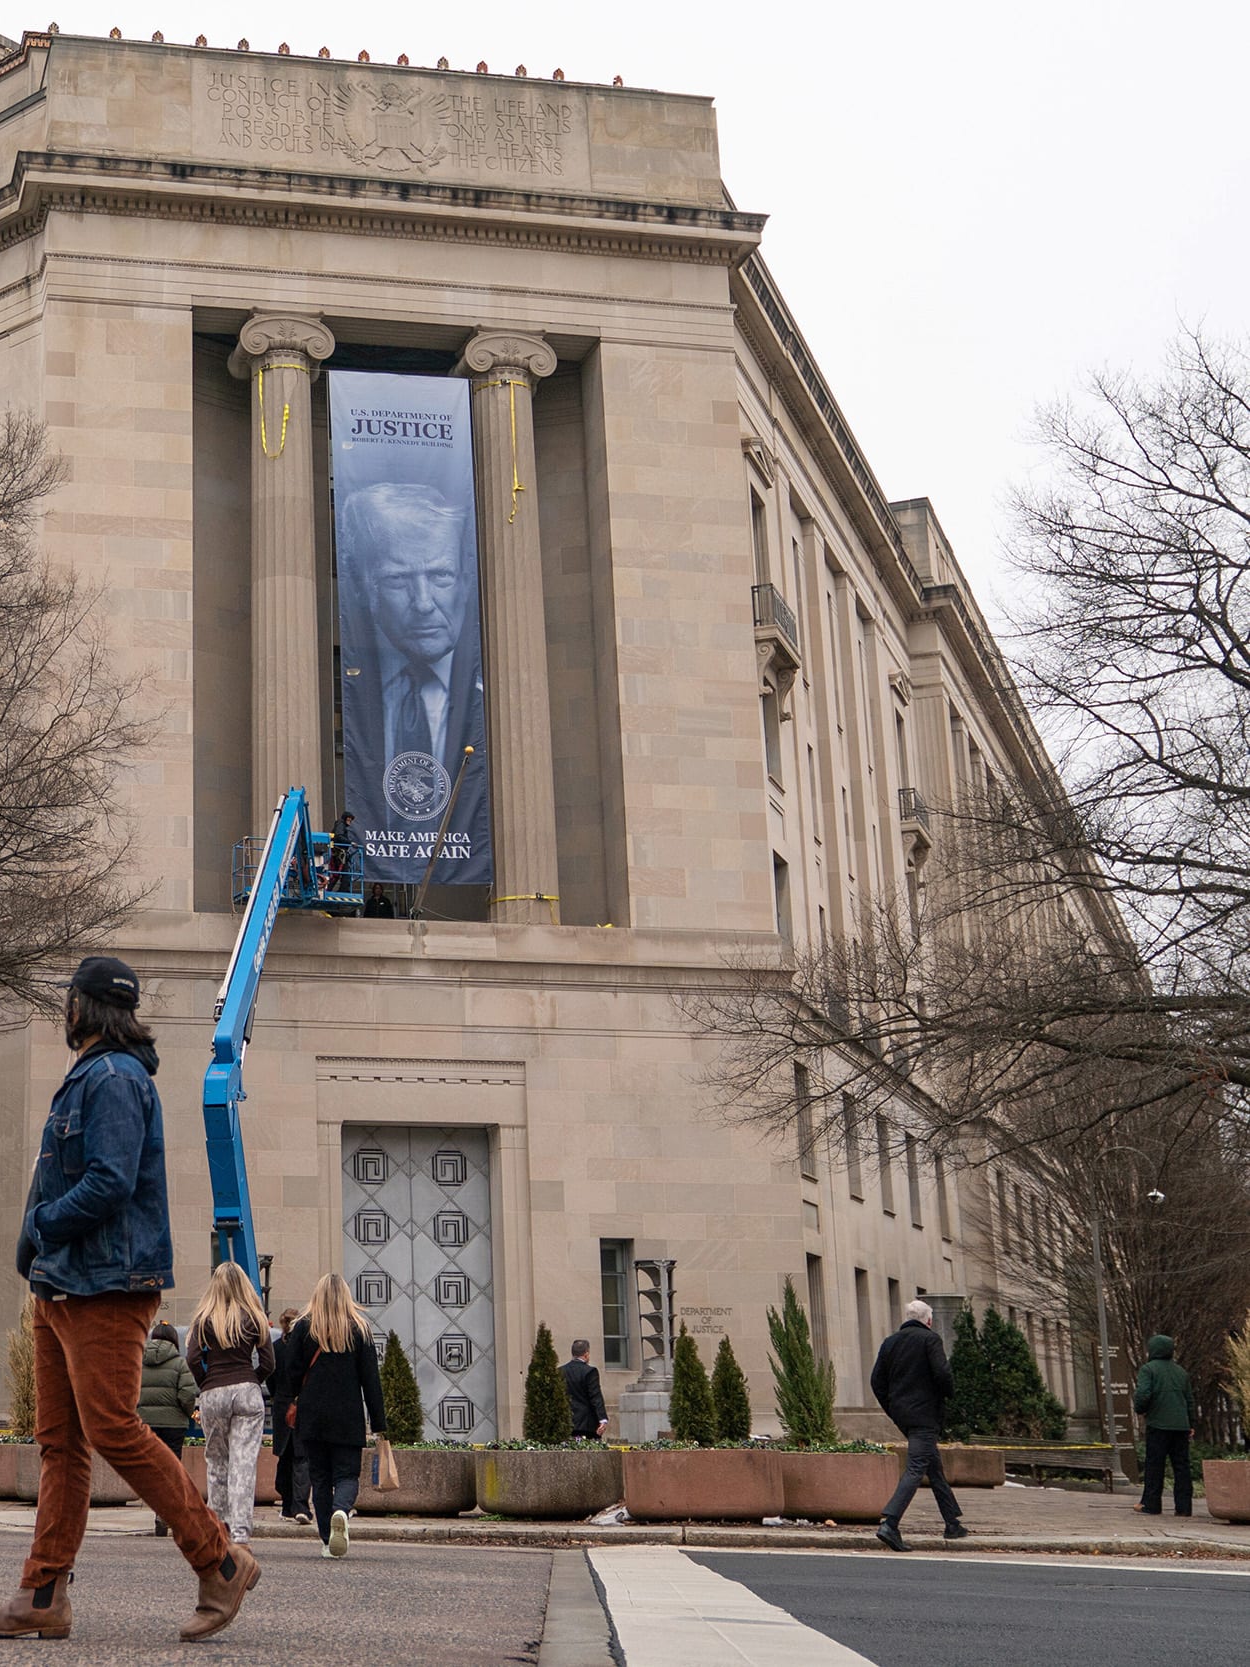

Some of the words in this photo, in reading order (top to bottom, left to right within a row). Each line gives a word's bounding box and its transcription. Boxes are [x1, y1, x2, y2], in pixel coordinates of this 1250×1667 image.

[206, 72, 298, 94] JUSTICE
[310, 82, 330, 97] IN
[448, 94, 483, 112] THE
[494, 98, 527, 115] LIFE
[535, 103, 573, 120] AND
[207, 87, 301, 109] CONDUCT
[307, 96, 331, 114] OF
[453, 109, 486, 126] THE
[495, 114, 546, 131] STATE
[556, 119, 572, 134] IS
[223, 103, 333, 127] POSSIBLE
[446, 124, 489, 140] ONLY
[494, 128, 515, 143] AS
[521, 130, 562, 147] FIRST
[222, 117, 235, 133] IT
[242, 120, 311, 139] RESIDES
[319, 126, 335, 141] IN
[453, 138, 487, 155] THE
[497, 142, 563, 161] HEARTS
[218, 131, 252, 148] AND
[259, 135, 313, 154] SOULS
[320, 141, 338, 157] OF
[448, 152, 479, 169] THE
[485, 156, 565, 177] CITIZENS.
[350, 408, 369, 417] U.S.
[371, 410, 438, 422] DEPARTMENT
[439, 414, 453, 422] OF
[351, 418, 454, 441] JUSTICE
[387, 439, 420, 447] KENNEDY
[421, 441, 454, 449] BUILDING
[365, 830, 405, 842] MAKE
[407, 831, 471, 843] AMERICA
[365, 843, 411, 858] SAFE
[413, 844, 471, 859] AGAIN
[680, 1307, 733, 1316] DEPARTMENT
[701, 1316, 712, 1325] OF
[691, 1325, 725, 1334] JUSTICE
